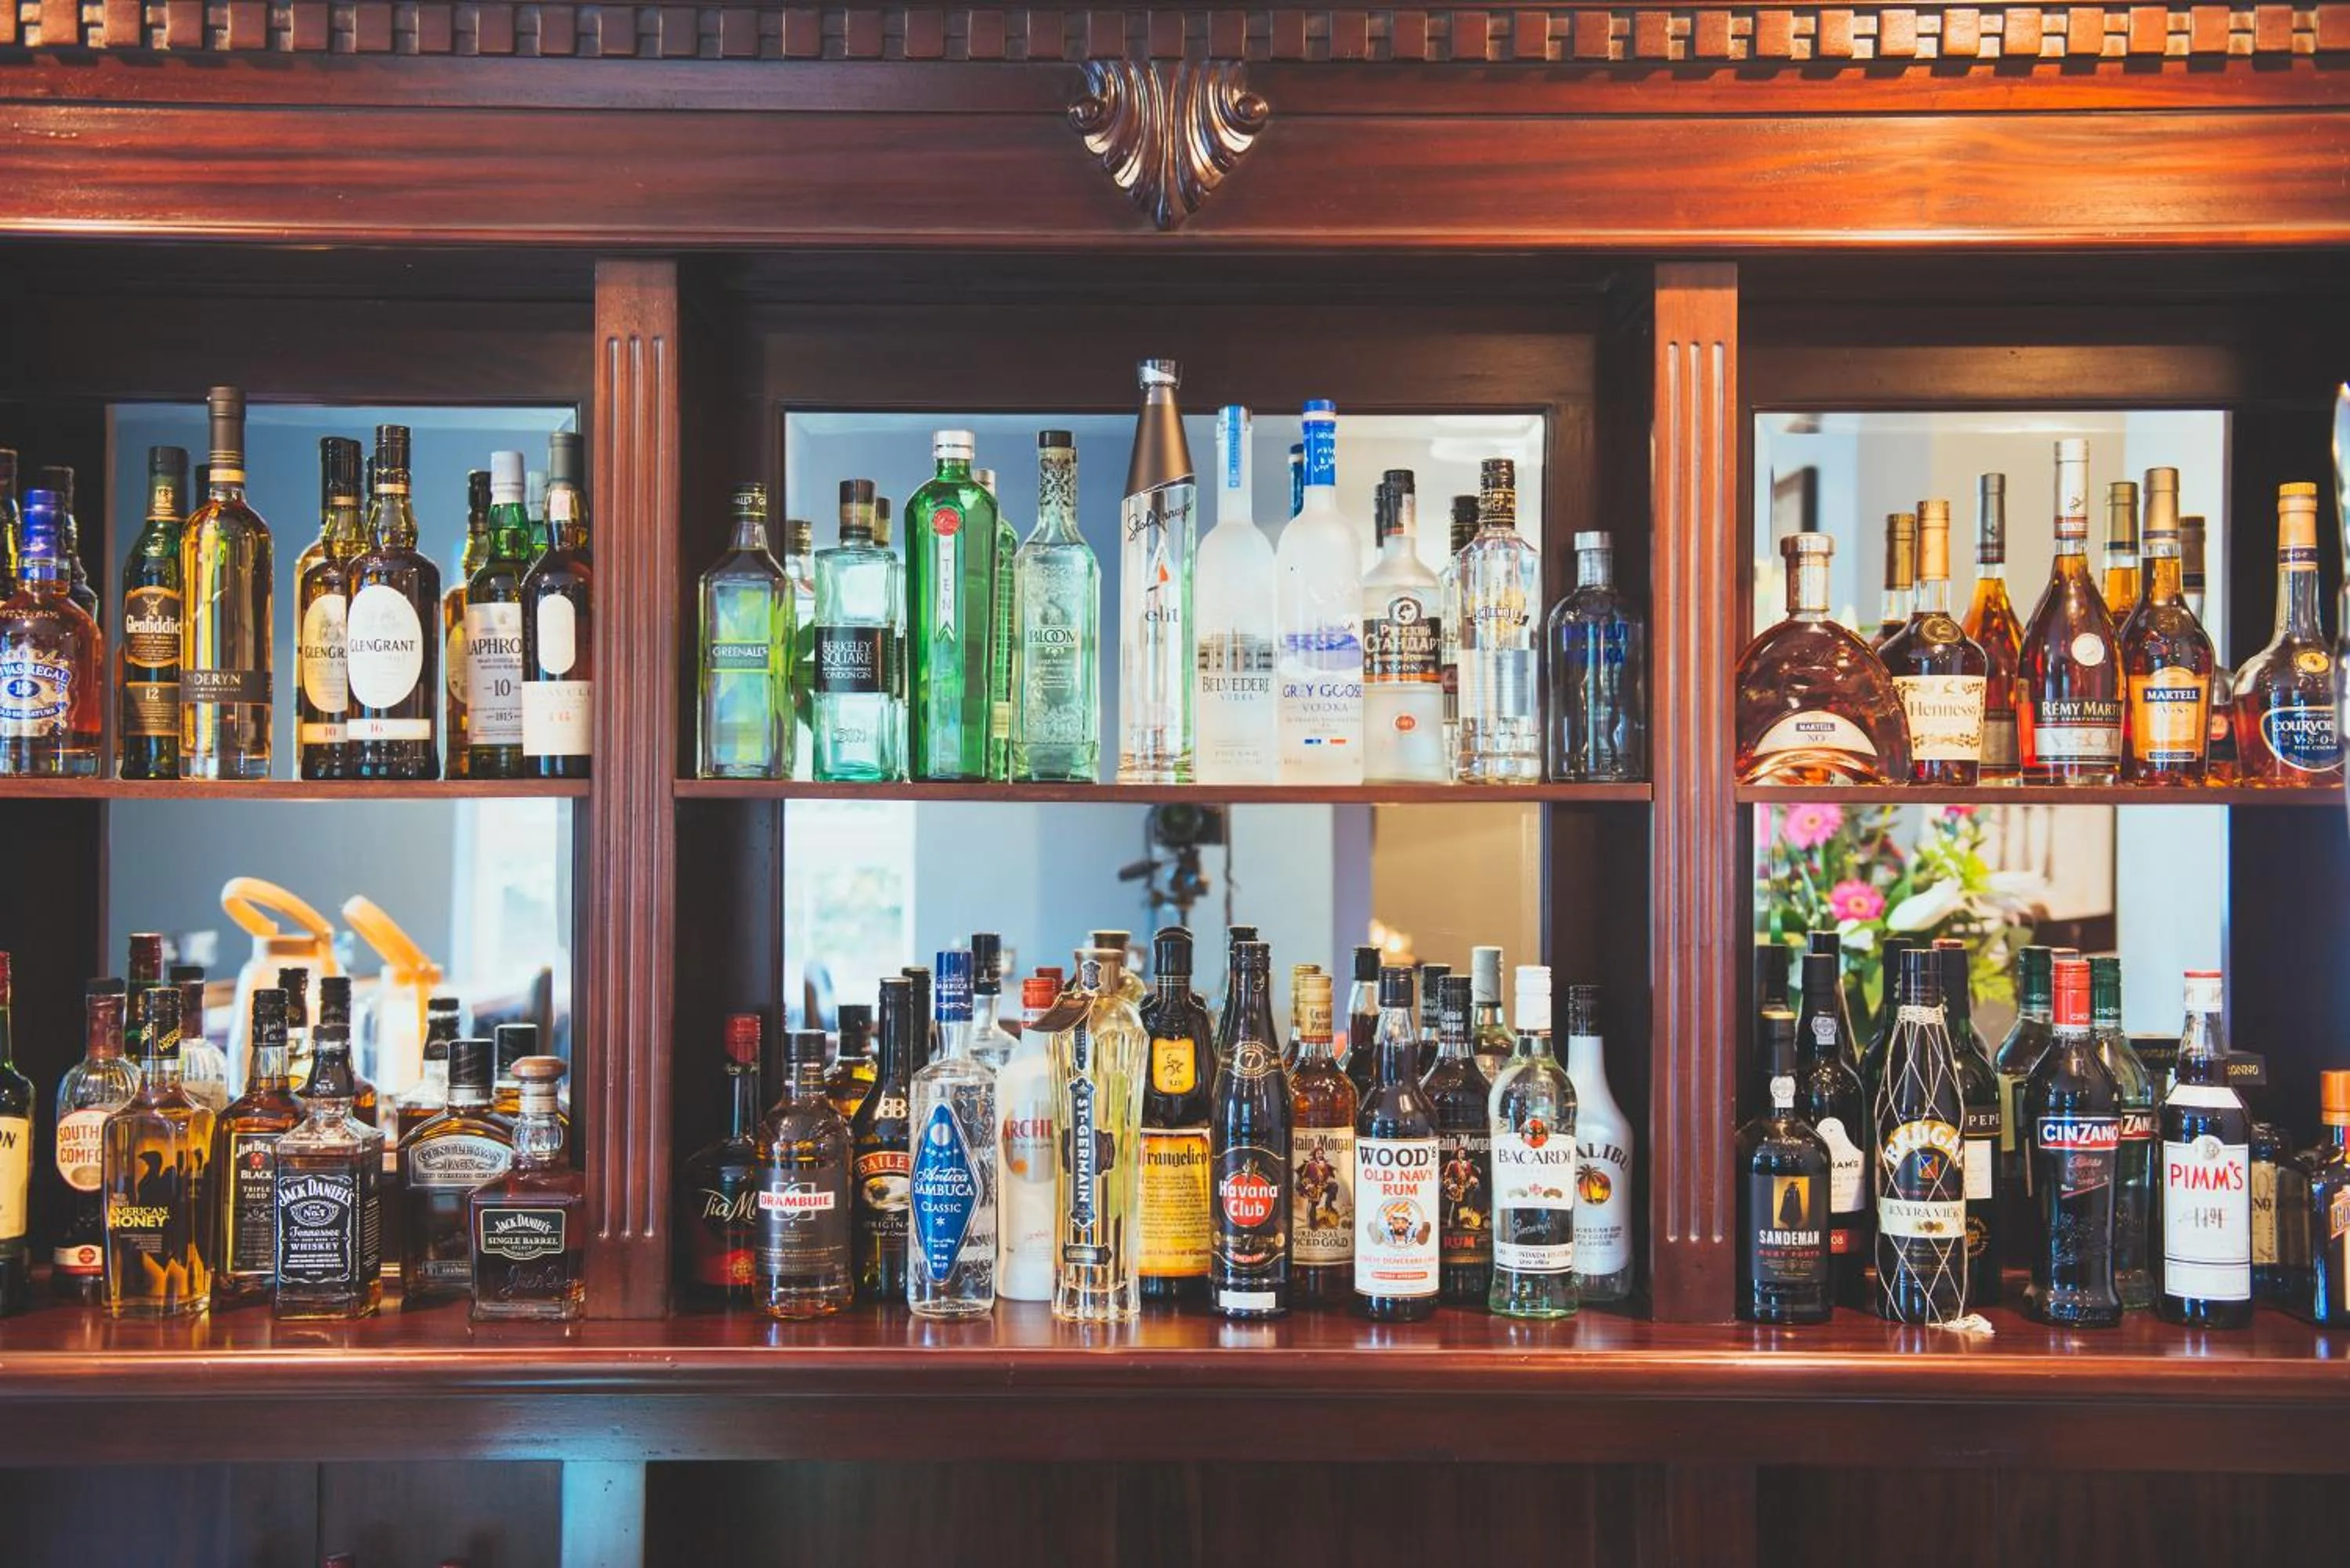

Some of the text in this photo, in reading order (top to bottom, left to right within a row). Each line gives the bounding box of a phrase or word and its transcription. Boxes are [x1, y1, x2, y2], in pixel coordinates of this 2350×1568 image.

[1144, 605, 1177, 623] elit
[126, 614, 181, 634] Glenfiddic
[1029, 629, 1078, 643] BLOOM
[306, 645, 347, 659] GLENGR
[822, 640, 872, 652] BERKELEY
[822, 651, 872, 666] SQUARE
[28, 664, 69, 682] REGAL
[145, 687, 159, 700] 12
[494, 679, 510, 696] 10
[2146, 689, 2197, 700] MARTELL
[59, 1125, 101, 1143] SOUTH
[2042, 1122, 2120, 1144] CINZANO
[254, 1140, 273, 1154] BEA
[1076, 1098, 1090, 1205] ST-GERMAIN
[1295, 1136, 1314, 1151] tain
[859, 1151, 910, 1172] BAILE
[1360, 1146, 1437, 1167] WOOD'S
[1575, 1143, 1630, 1172] ALIBU
[240, 1170, 273, 1180] BLACK
[1364, 1168, 1434, 1182] OLD NAVY
[2171, 1161, 2243, 1190] PIMM'S
[278, 1179, 354, 1207] JACK DANIEL'S
[914, 1181, 974, 1196] SAMBUCA
[1219, 1180, 1278, 1198] Havana
[1382, 1183, 1418, 1196] RUM
[761, 1192, 831, 1206] DRAMBUIE
[920, 1201, 962, 1213] CLASSIC
[1229, 1200, 1265, 1216] Club
[108, 1215, 165, 1228] HONEY
[495, 1216, 516, 1234] JACK
[1759, 1229, 1820, 1245] SANDEMAN
